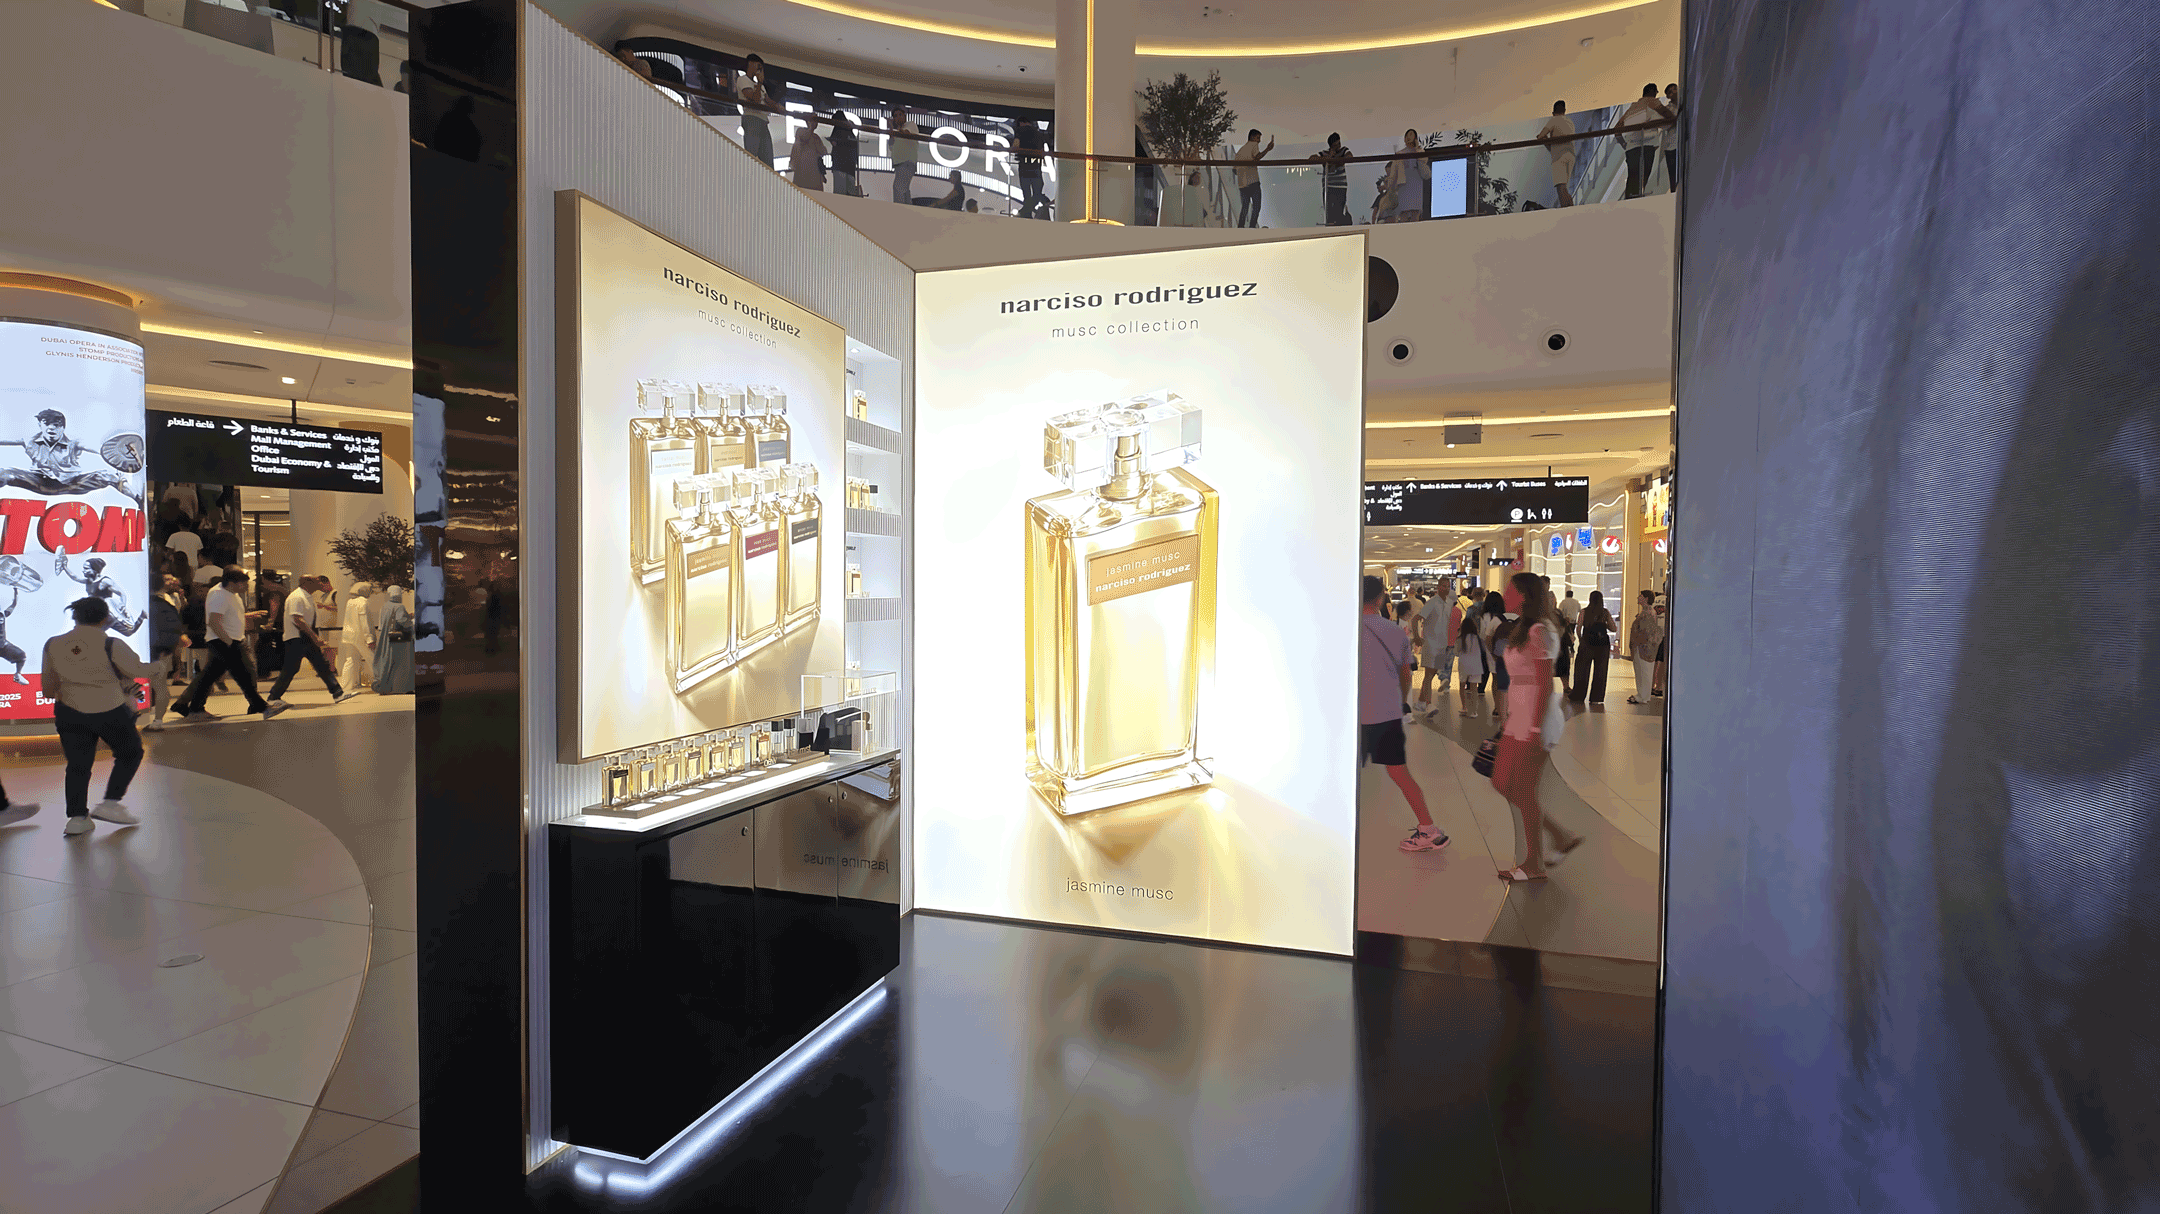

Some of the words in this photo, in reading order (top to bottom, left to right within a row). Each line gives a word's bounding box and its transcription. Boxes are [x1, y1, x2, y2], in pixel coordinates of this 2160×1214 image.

[663, 265, 728, 306] narciso
[733, 298, 802, 338] rodriguez
[1000, 291, 1103, 314] narciso
[1113, 282, 1258, 306] rodriguez
[698, 308, 726, 328] musc
[730, 321, 778, 348] collection
[1052, 324, 1098, 339] musc
[1106, 317, 1200, 335] collection
[69, 339, 96, 347] OPERA
[45, 350, 74, 358] GLYNIS
[76, 353, 120, 364] HENDERSON
[250, 424, 279, 436] Banks
[280, 427, 288, 436] &
[289, 428, 328, 440] Services
[250, 434, 272, 444] Mall
[273, 437, 332, 450] Management
[250, 445, 280, 455] Office
[251, 454, 279, 465] Dubai
[281, 457, 323, 468] Economy
[324, 460, 332, 468] &
[251, 464, 290, 475] Tourism
[1105, 557, 1148, 577] jasmine
[1151, 550, 1181, 566] musc
[1095, 575, 1136, 593] narciso
[1138, 563, 1192, 582] rodriguez
[1066, 877, 1125, 895] jasmine
[1131, 886, 1174, 901] musc
